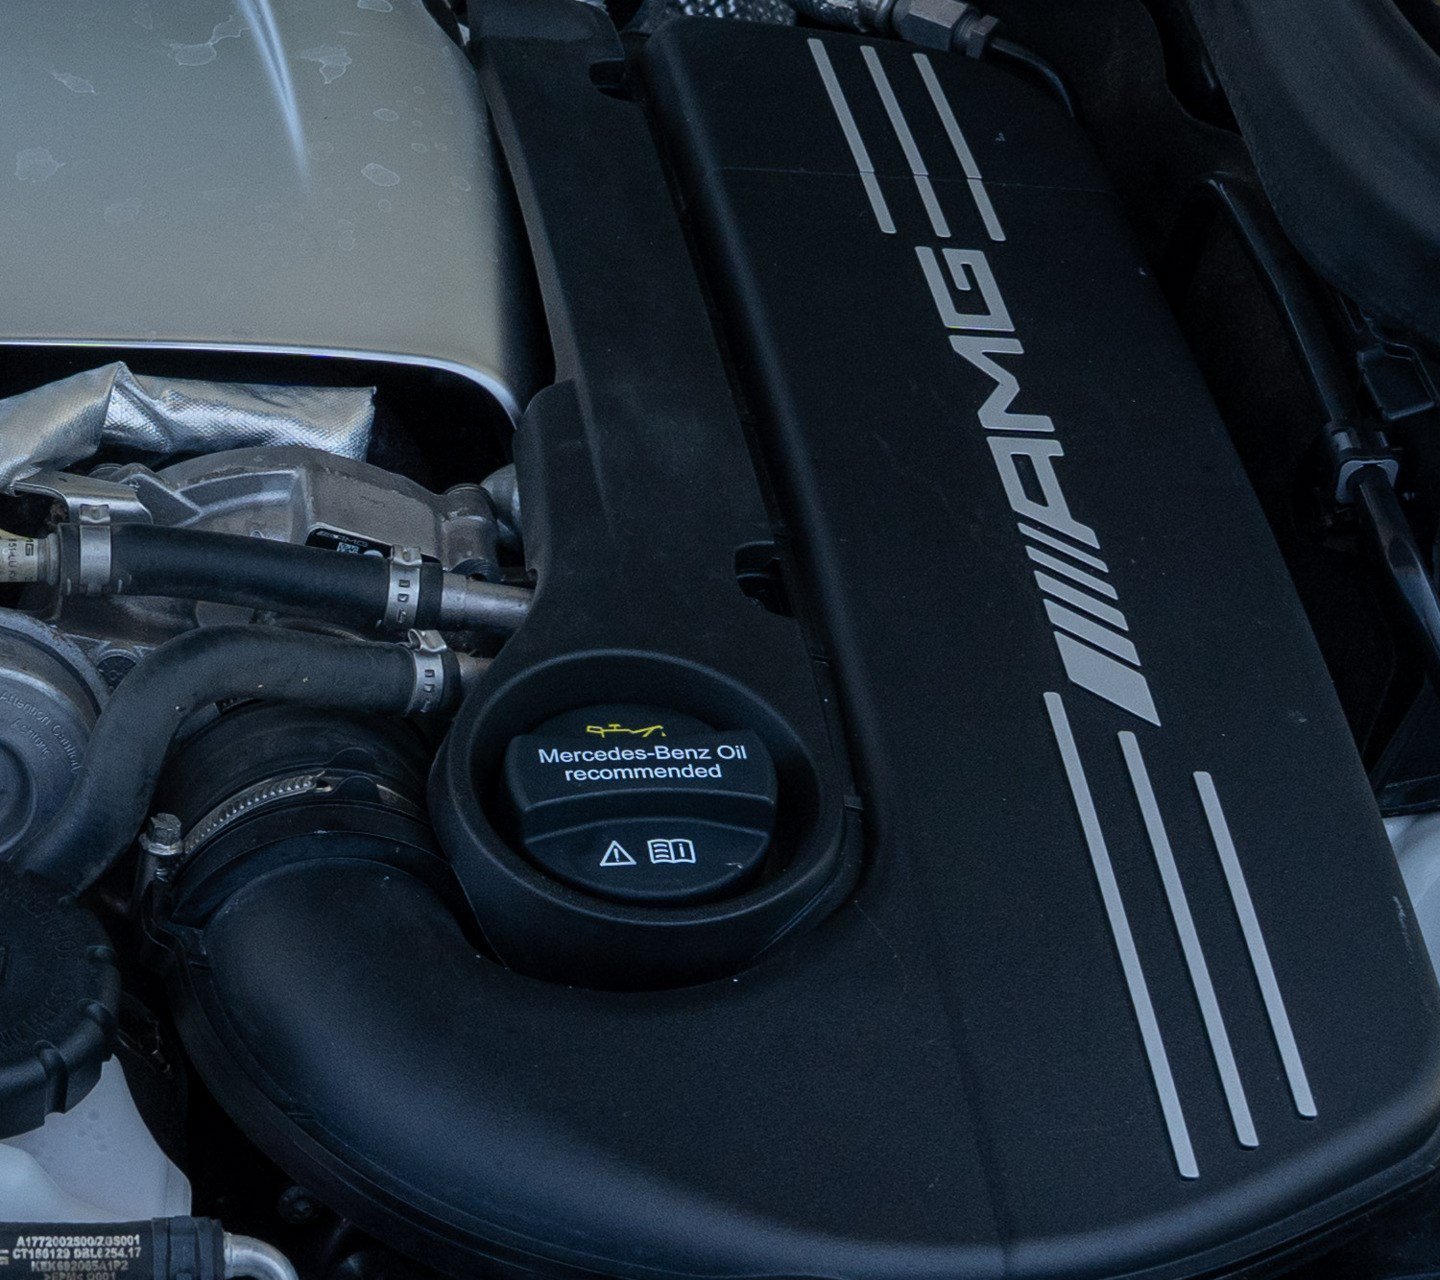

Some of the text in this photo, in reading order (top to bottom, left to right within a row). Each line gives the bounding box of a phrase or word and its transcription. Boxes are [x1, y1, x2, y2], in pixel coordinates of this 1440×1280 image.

[914, 245, 1100, 549] AMG
[538, 745, 747, 763] Mercedes-Benz Oil
[565, 764, 722, 781] recommended
